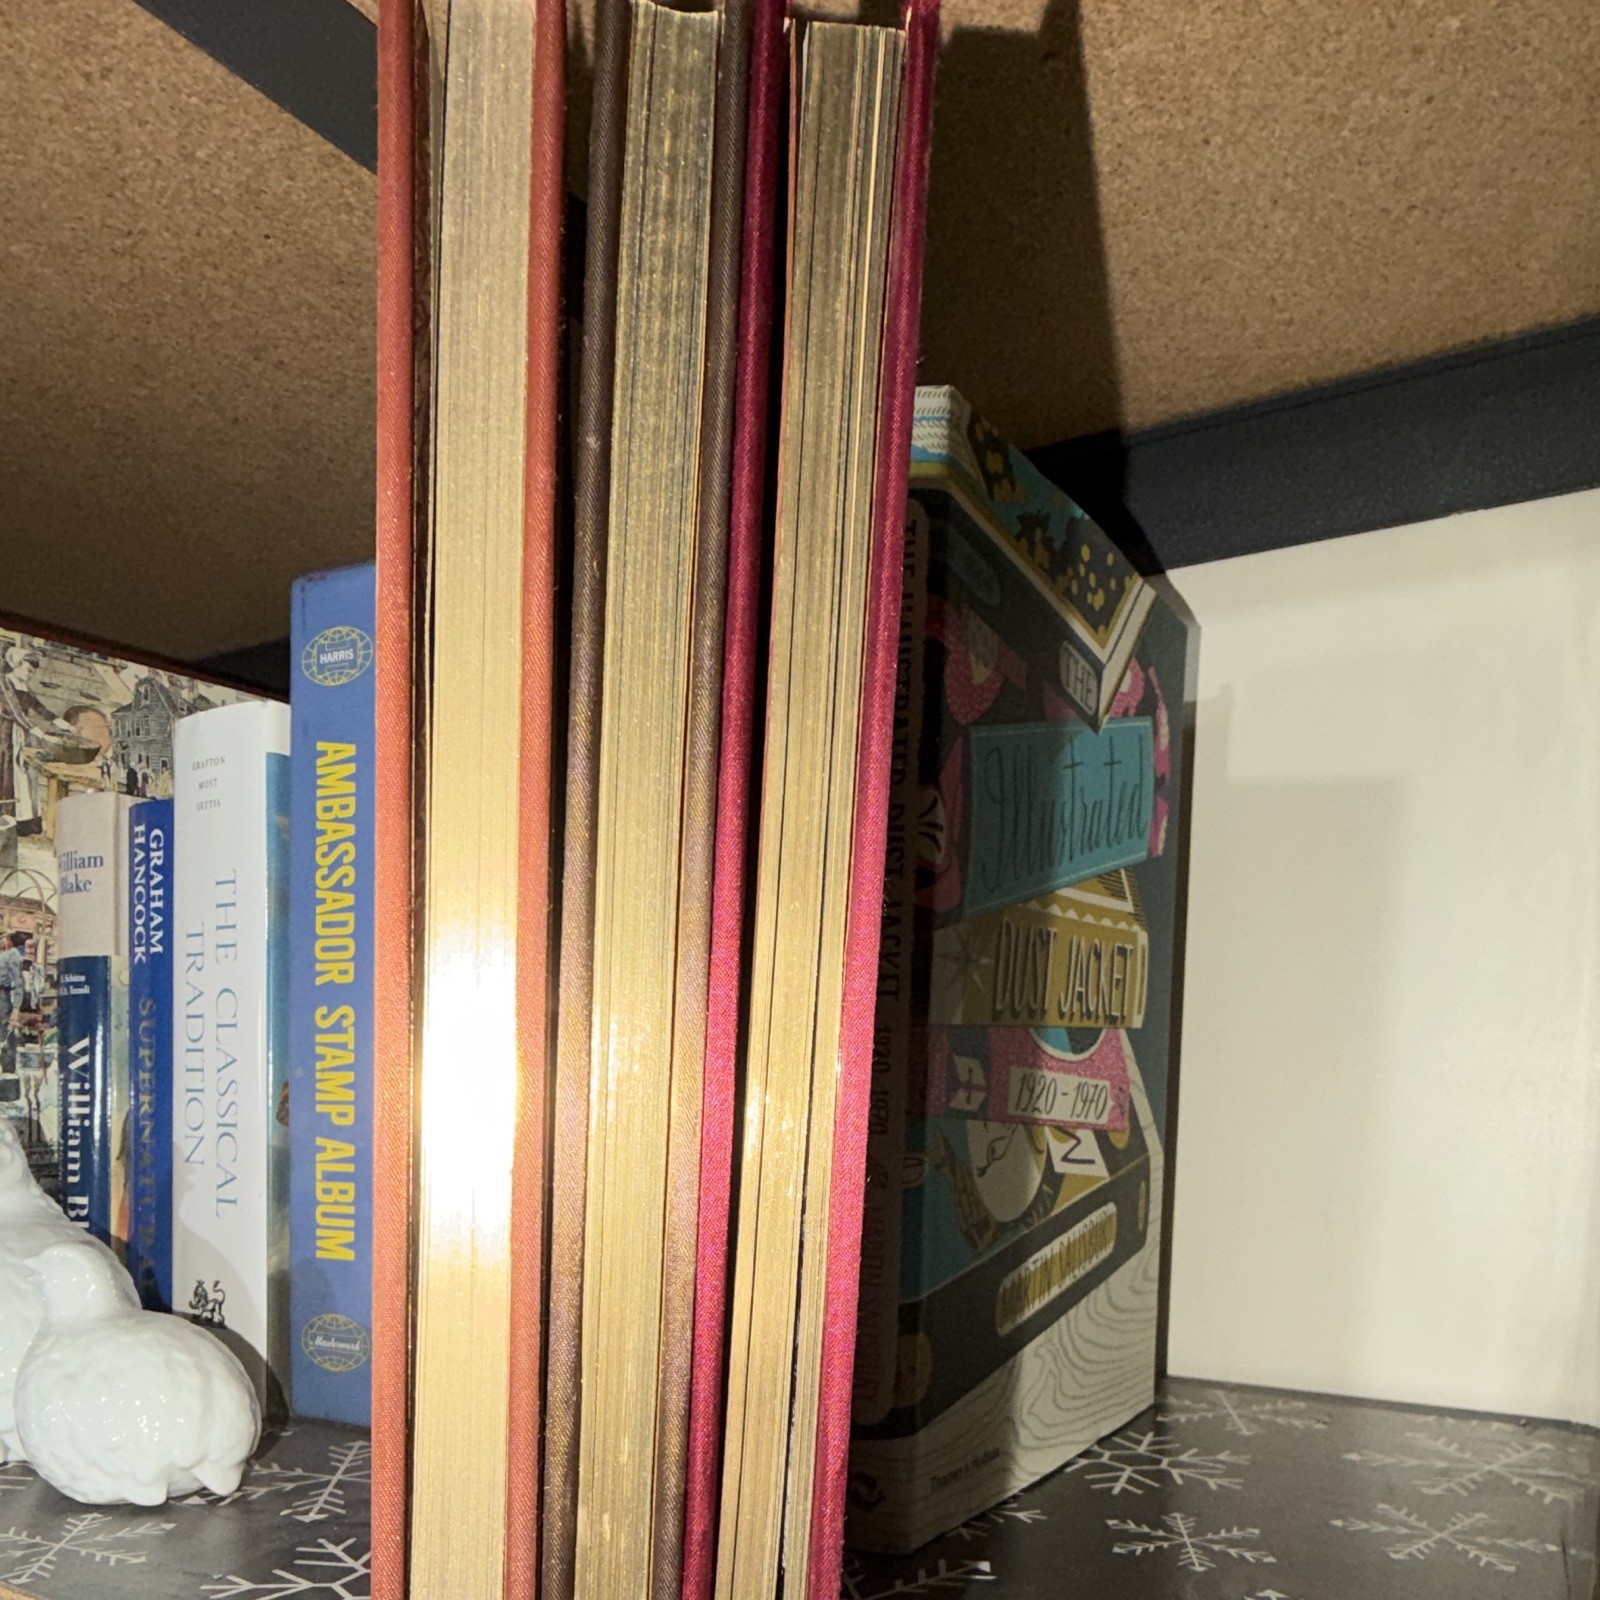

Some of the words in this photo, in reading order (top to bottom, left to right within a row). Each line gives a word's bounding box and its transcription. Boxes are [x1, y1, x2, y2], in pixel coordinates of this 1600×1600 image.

[320, 647, 355, 665] HARRIS
[1067, 655, 1097, 708] THE
[192, 755, 226, 771] GRAFTON
[58, 850, 104, 871] illiam
[133, 823, 147, 965] HANCOCK
[149, 828, 165, 955] GRAHAM
[215, 868, 238, 967] THE
[315, 741, 357, 987] AMBASSADOR
[994, 915, 1058, 1020] DUST
[1058, 930, 1135, 1024] JACKET
[184, 921, 206, 1166] TRADITION
[215, 987, 239, 1219] CLASSICAL
[315, 1005, 356, 1127] STAMP
[67, 1033, 91, 1183] William
[315, 1137, 356, 1262] ALBUM
